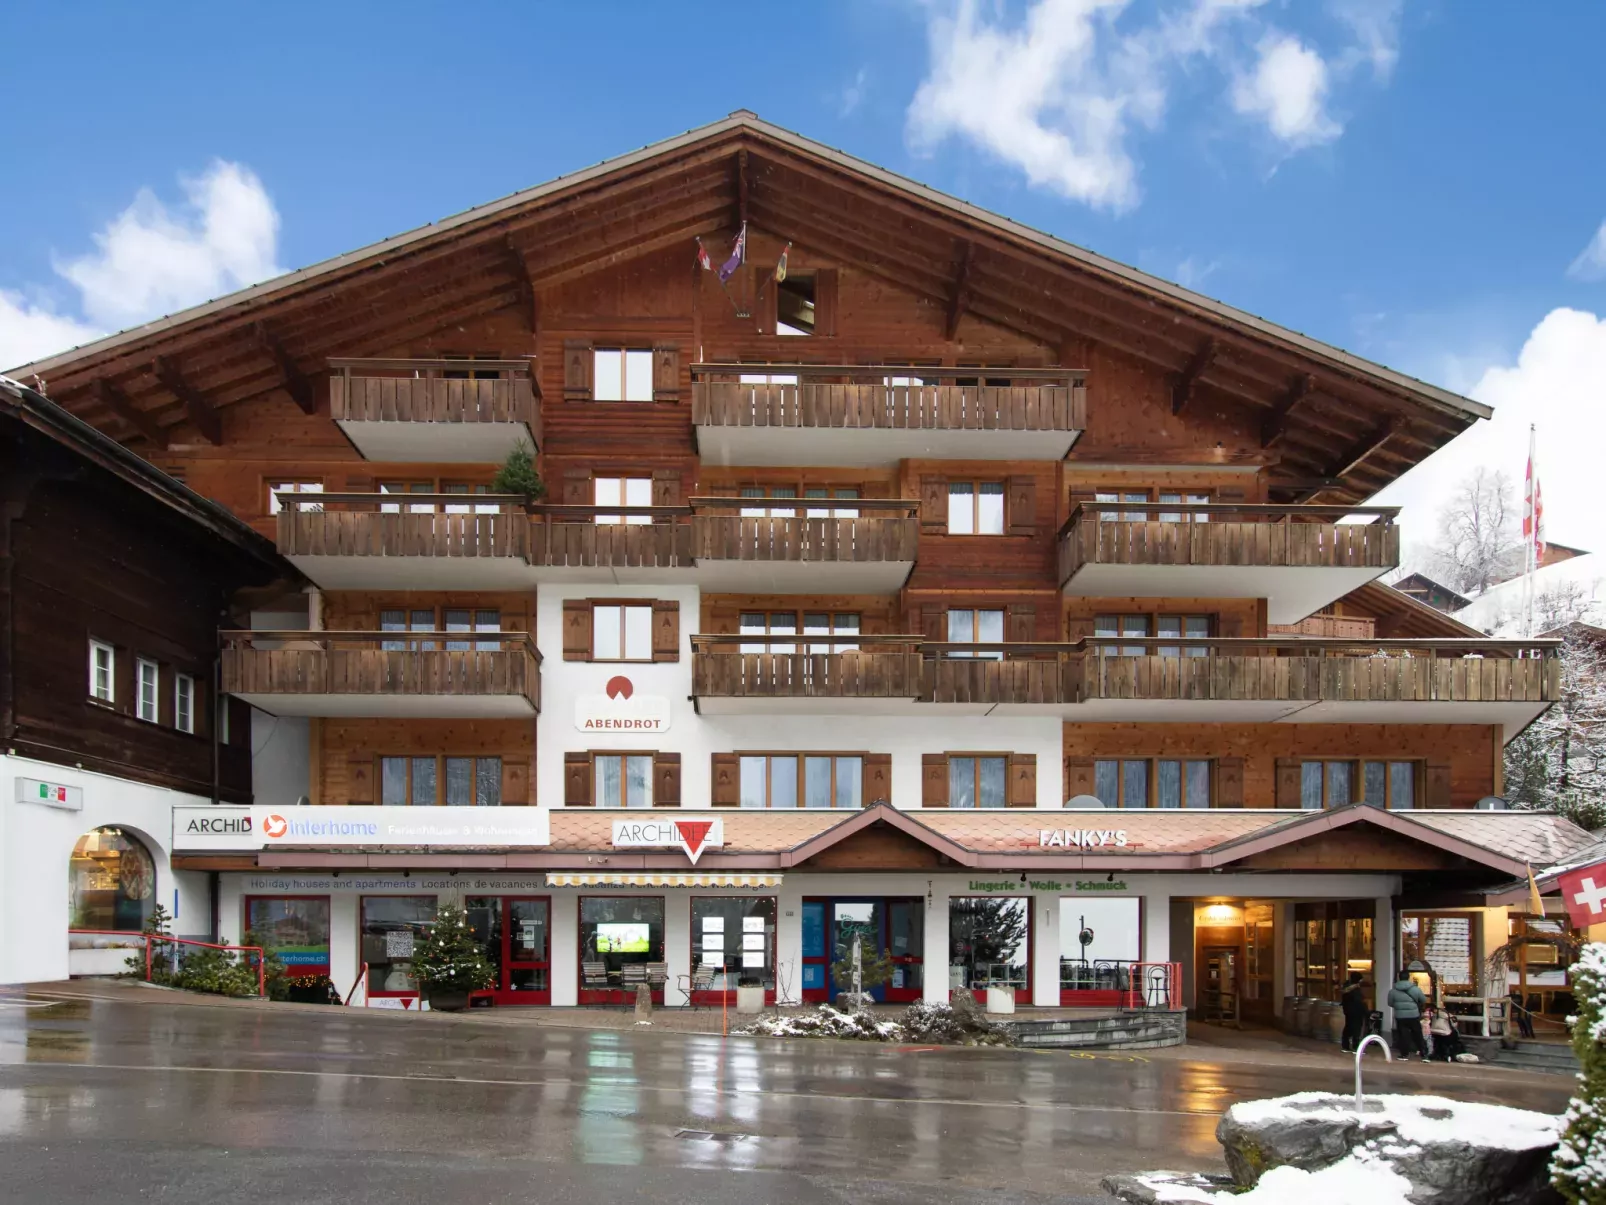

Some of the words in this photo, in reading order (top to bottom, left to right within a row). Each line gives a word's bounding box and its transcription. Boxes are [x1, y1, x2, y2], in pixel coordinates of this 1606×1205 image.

[585, 719, 661, 729] ABENDROT
[290, 819, 377, 836] interhome
[617, 824, 712, 842] ARCHIDEE
[1038, 829, 1128, 847] FANKY'S
[251, 879, 290, 890] Holiday
[294, 879, 330, 889] houses
[333, 879, 352, 889] and
[355, 879, 416, 891] apartments
[421, 879, 471, 889] Locations
[474, 879, 486, 889] de
[489, 880, 538, 889] vacances
[968, 880, 1016, 892] Lingerie
[1029, 880, 1062, 891] Wolle
[1075, 880, 1128, 891] Schmuck
